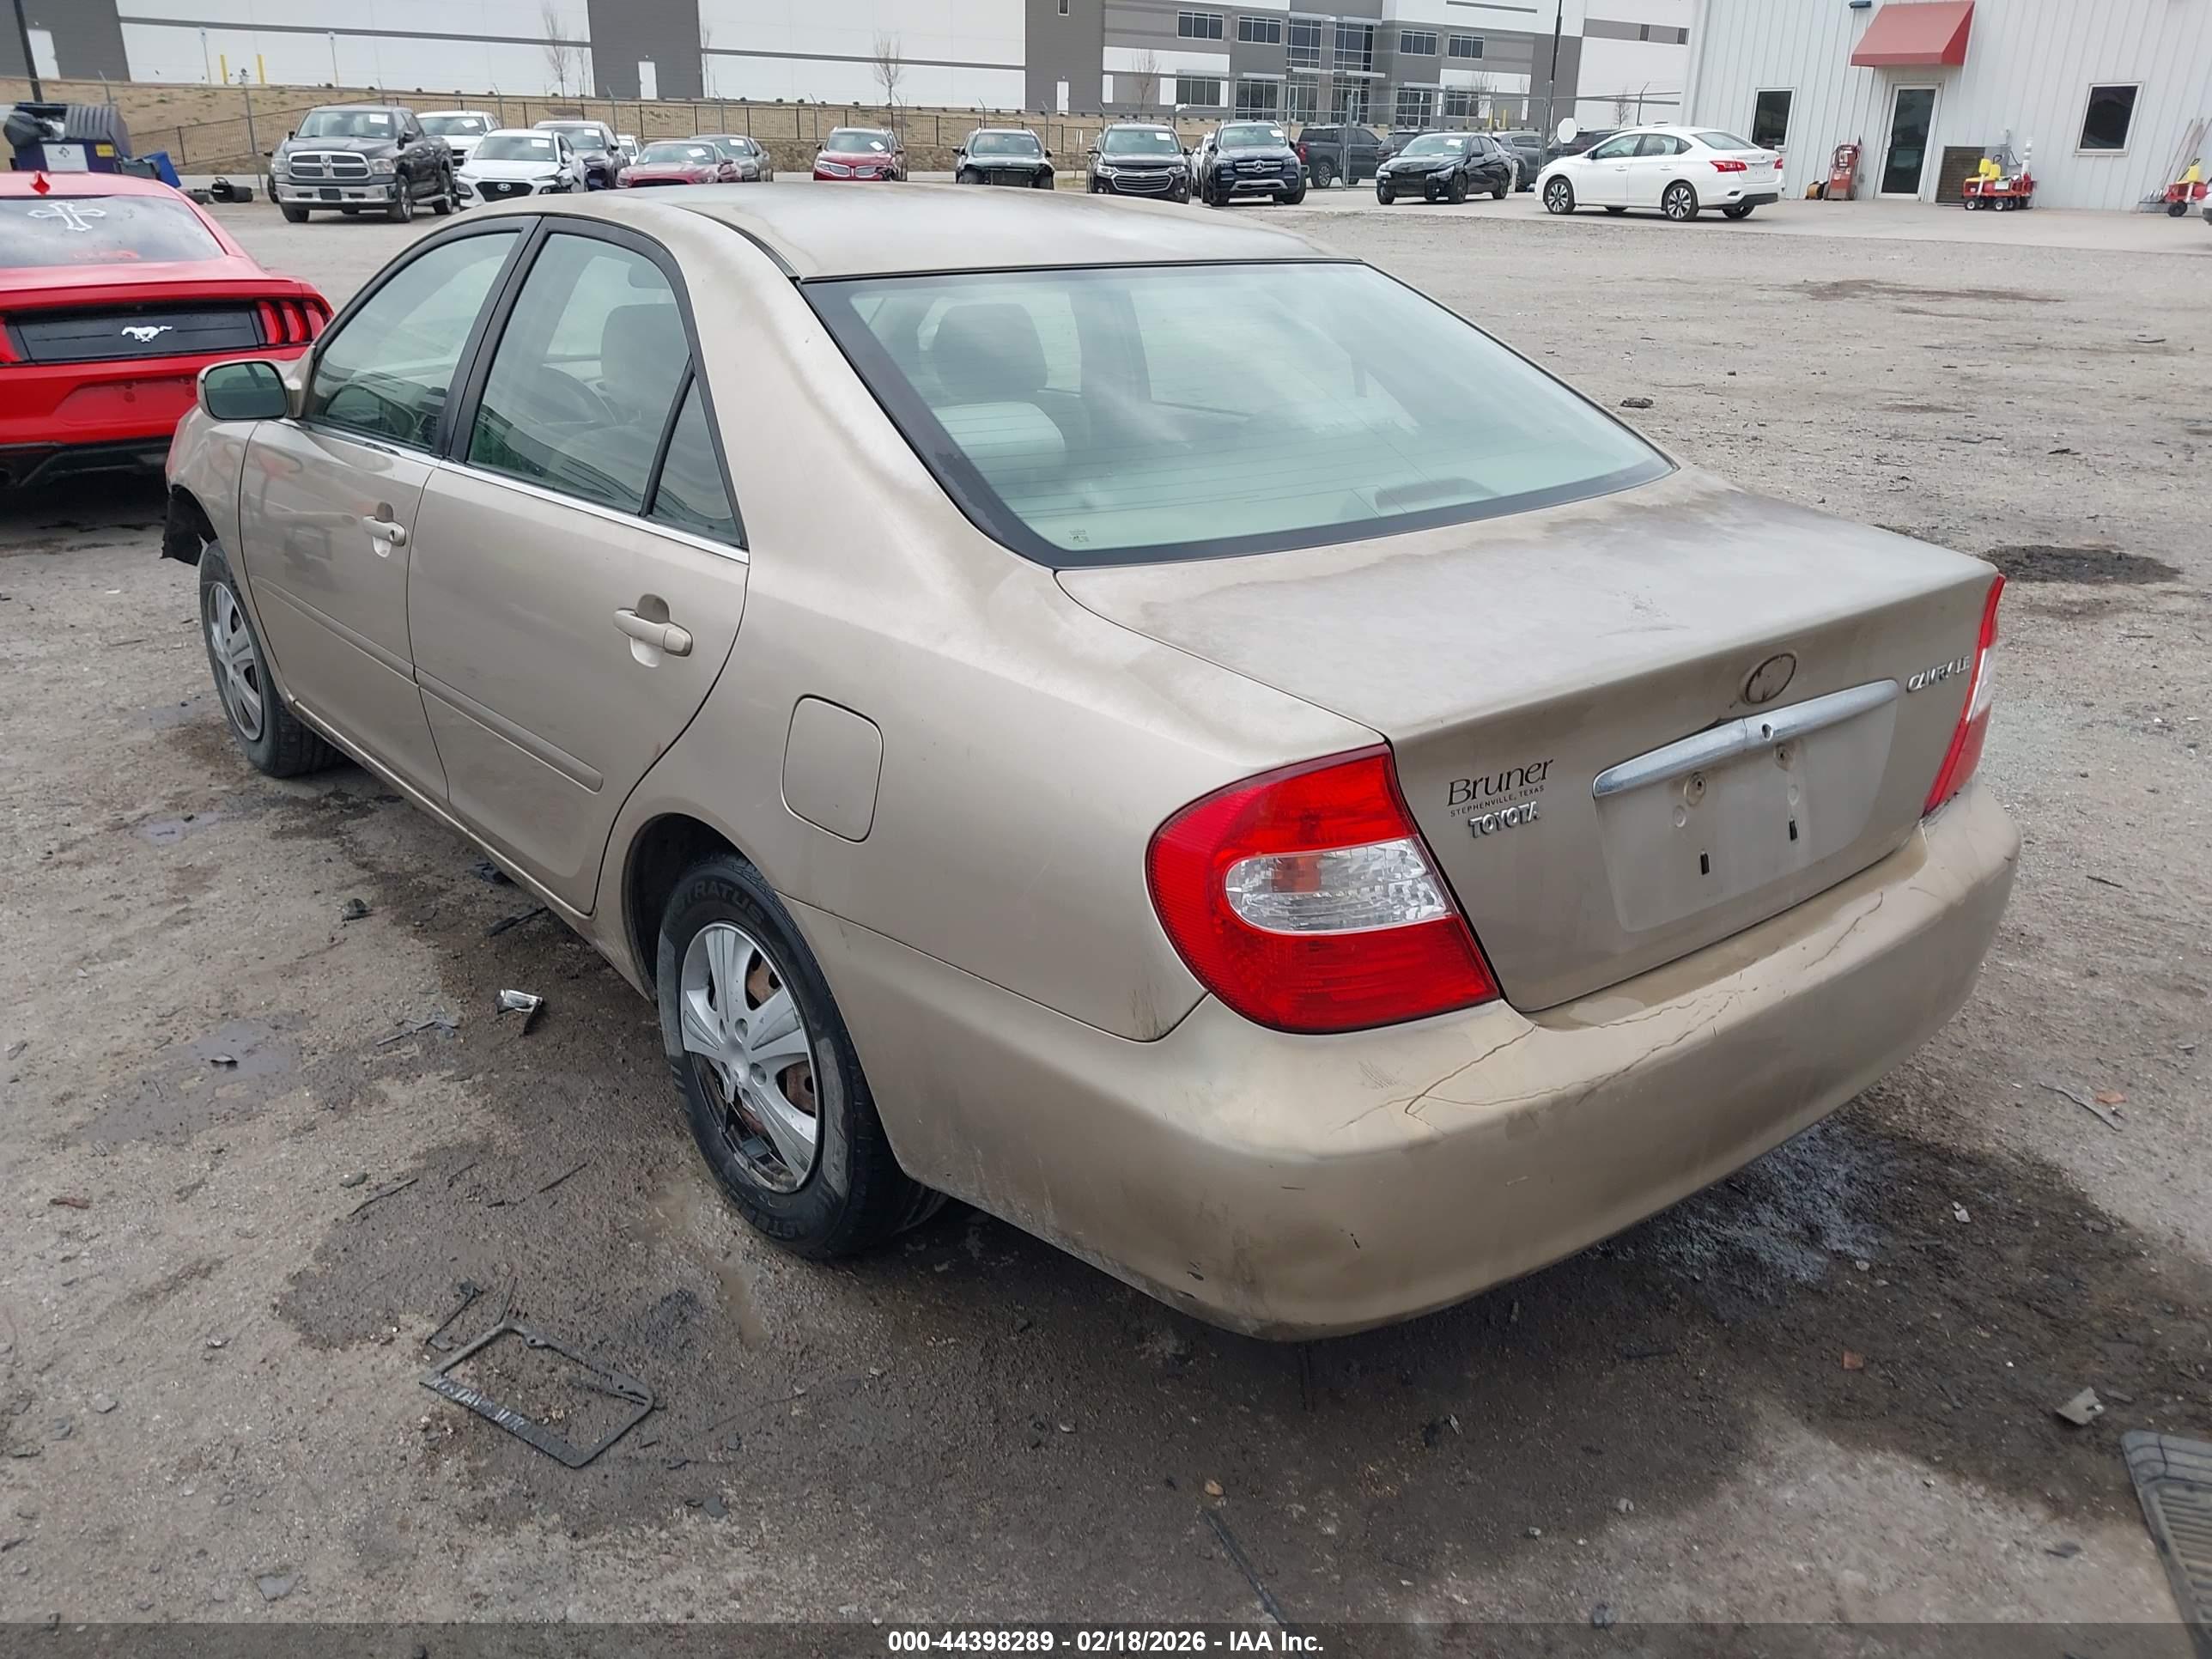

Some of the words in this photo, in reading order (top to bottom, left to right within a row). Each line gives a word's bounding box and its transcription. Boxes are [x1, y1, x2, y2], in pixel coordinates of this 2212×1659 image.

[1447, 759, 1554, 806] Bruner
[1450, 794, 1517, 817] STEPHENVILLE,
[1519, 785, 1545, 798] TEXAS
[1468, 801, 1540, 839] TOYOTA
